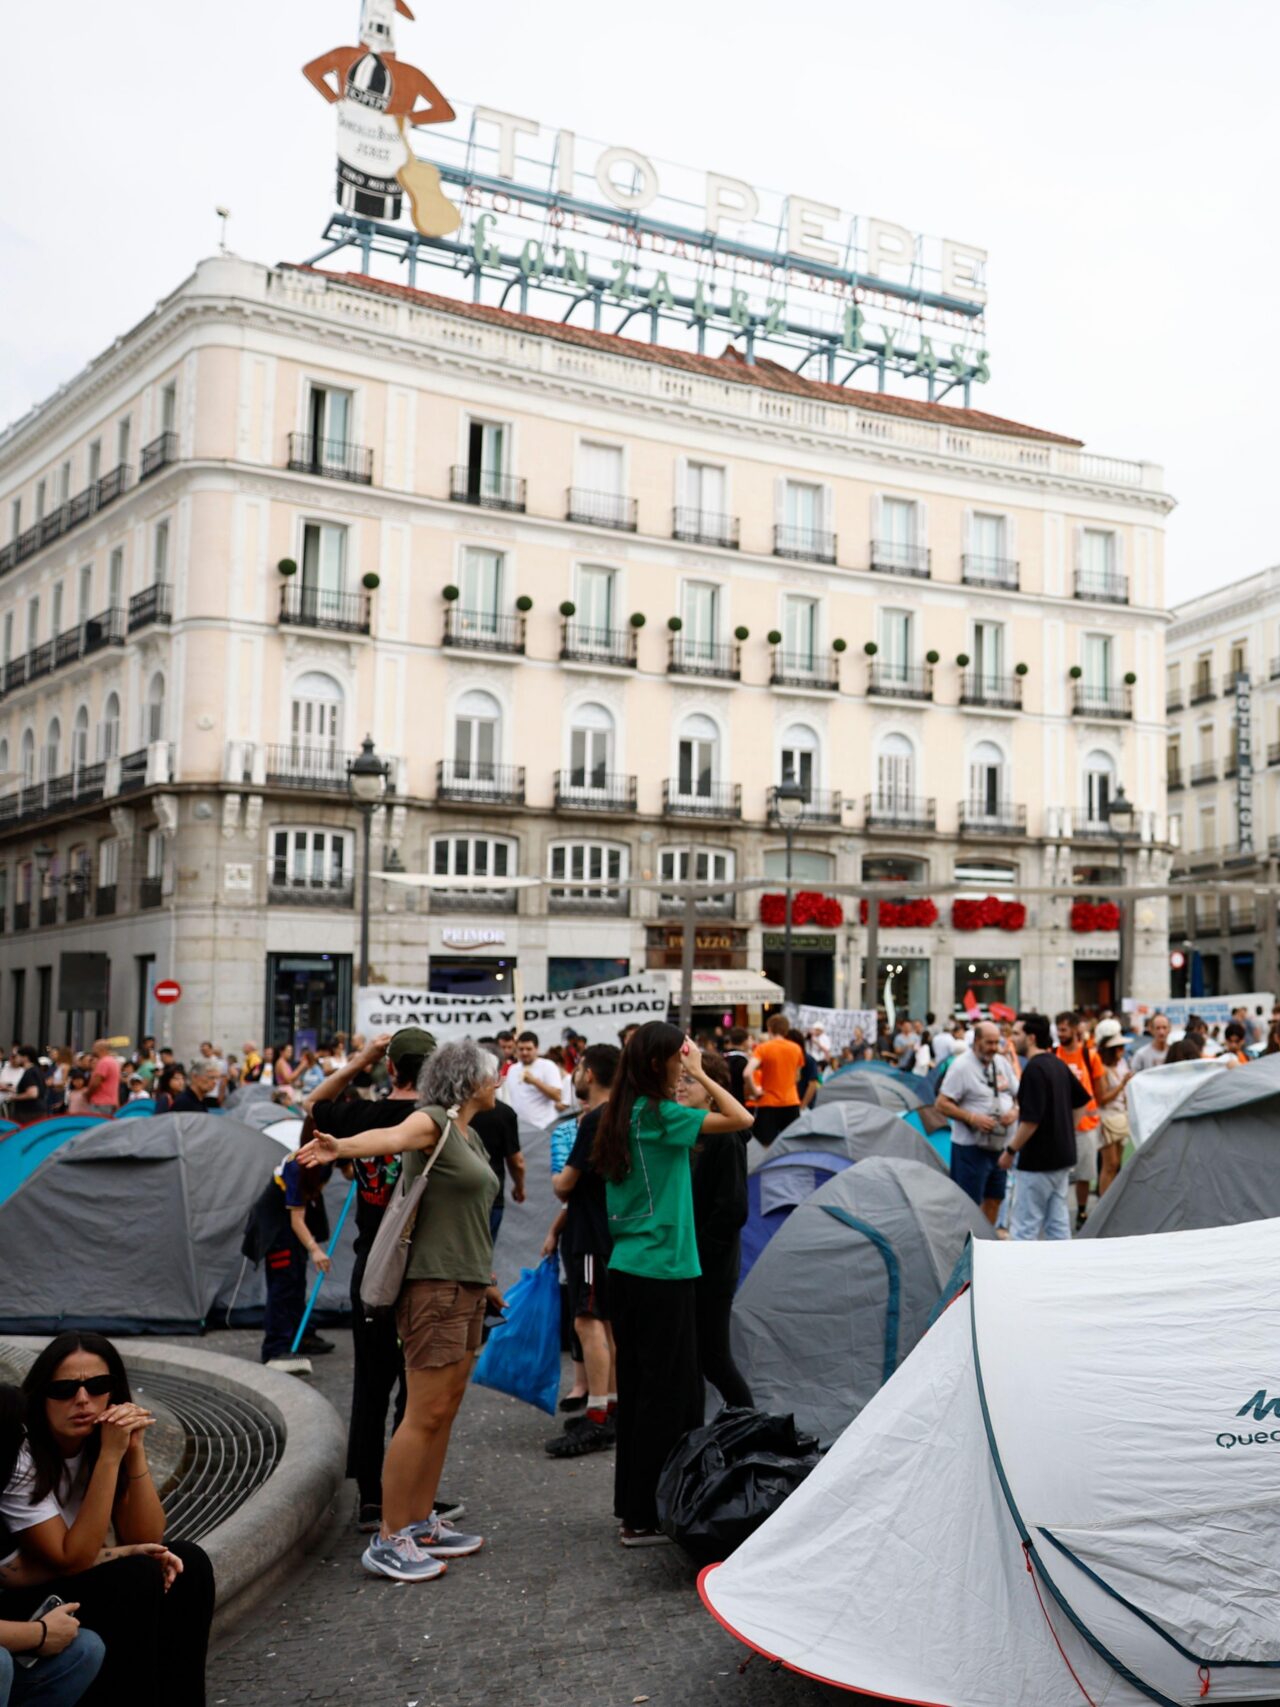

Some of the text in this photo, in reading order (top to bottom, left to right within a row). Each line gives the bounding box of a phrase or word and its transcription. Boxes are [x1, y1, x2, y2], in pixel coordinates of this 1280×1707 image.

[464, 185, 522, 218] SOL
[548, 206, 584, 231] DE
[475, 105, 988, 305] TIO PEPE
[474, 213, 990, 384] GONZALEZ BYASS
[442, 928, 506, 944] PRIMOR
[1074, 947, 1118, 957] SEPHOR
[369, 999, 666, 1025] GRATUITA Y DE CALIDAD
[379, 993, 505, 1006] VIVIENDA
